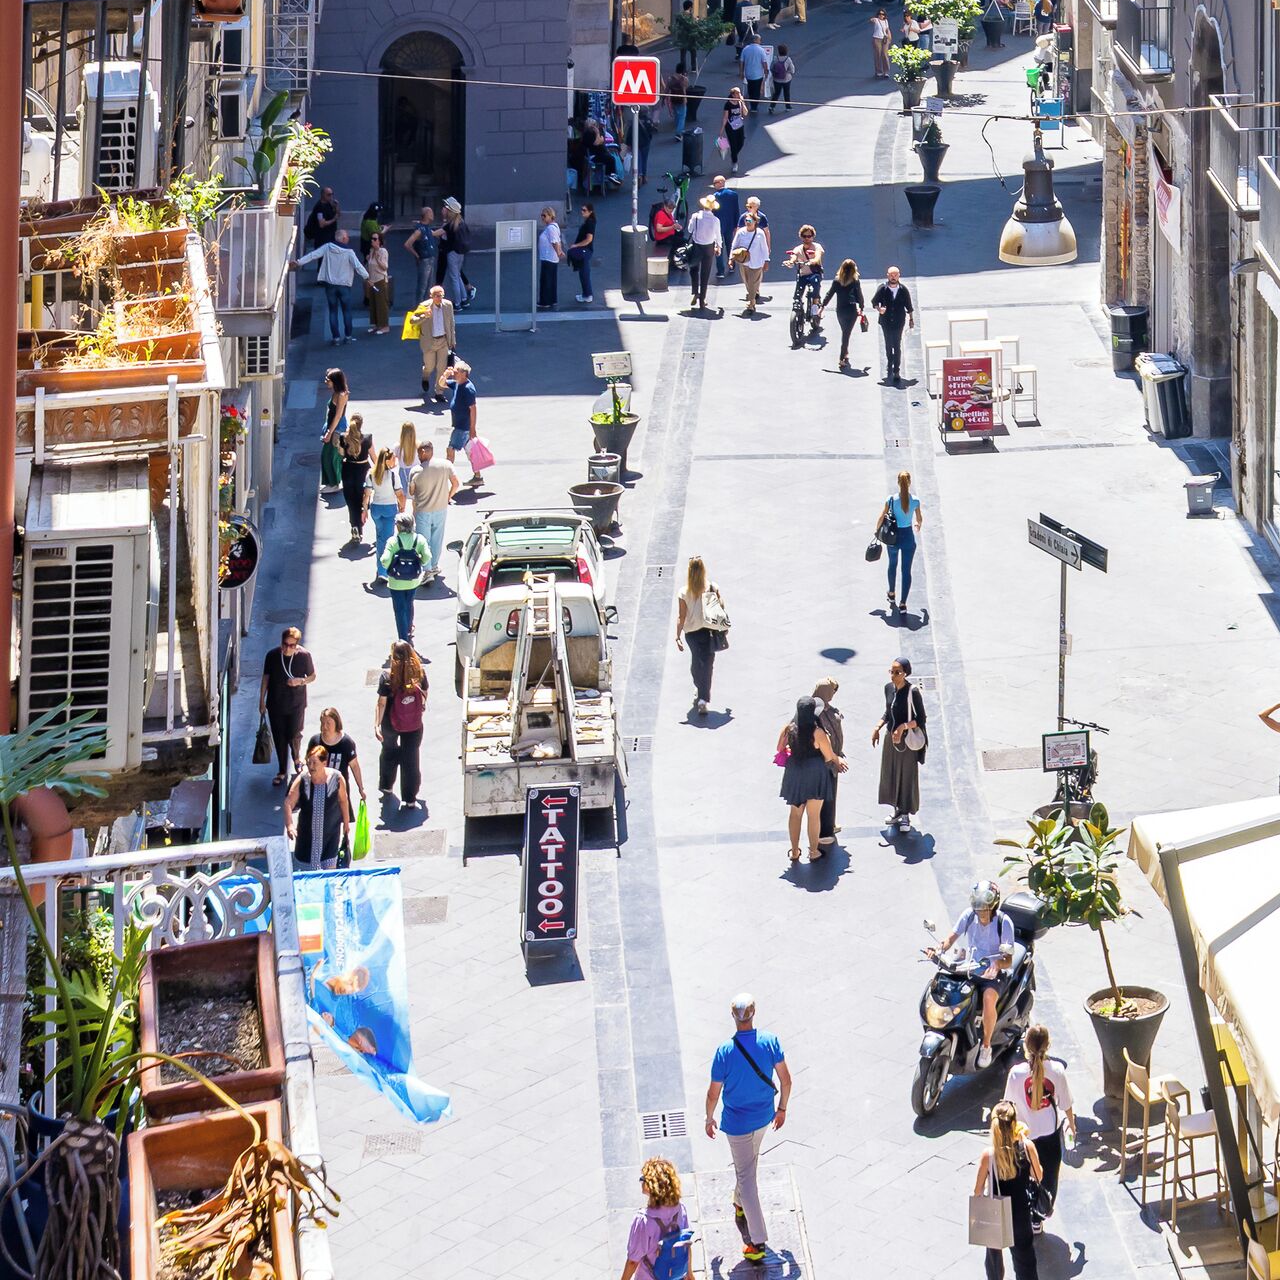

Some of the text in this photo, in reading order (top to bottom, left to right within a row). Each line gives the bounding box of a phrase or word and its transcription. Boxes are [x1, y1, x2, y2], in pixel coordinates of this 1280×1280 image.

[617, 69, 653, 95] M
[950, 410, 989, 418] Polpettine
[537, 808, 566, 917] TATTOO
